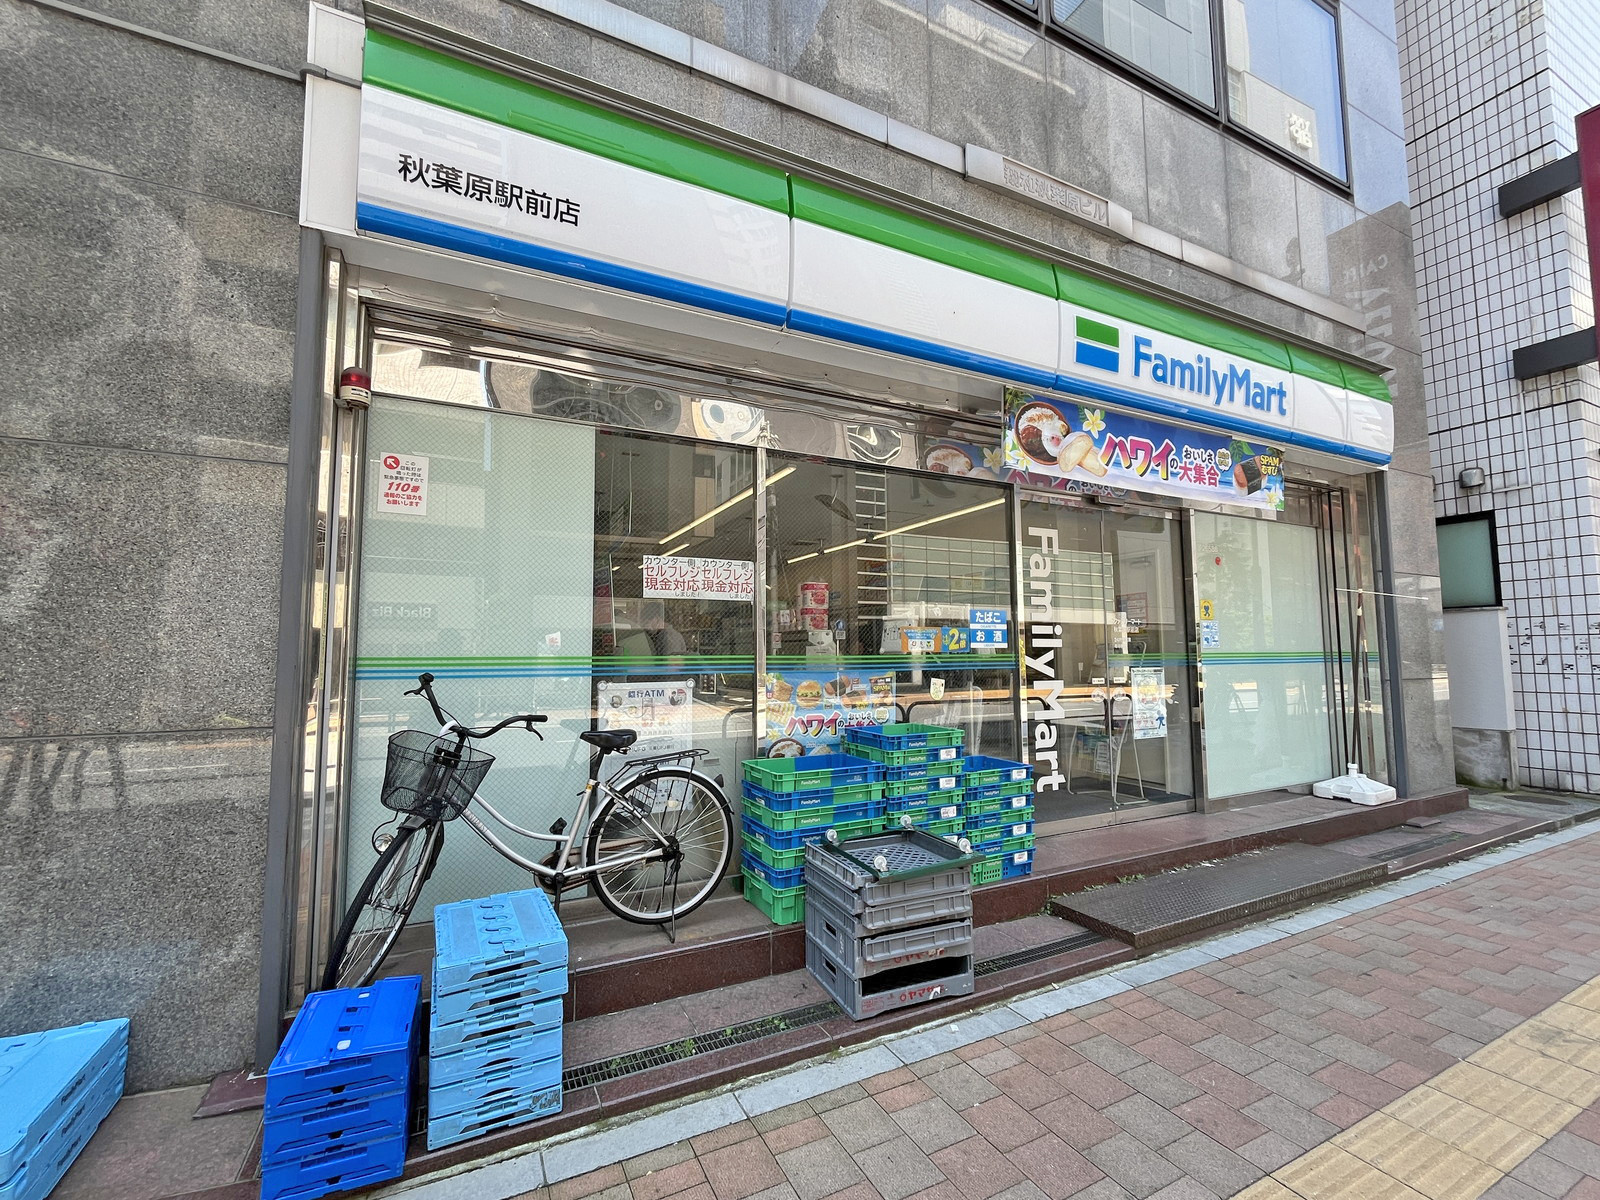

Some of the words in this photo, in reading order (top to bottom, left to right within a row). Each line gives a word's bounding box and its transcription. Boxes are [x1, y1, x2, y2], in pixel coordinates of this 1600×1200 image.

[398, 153, 581, 227] 秋葉原駅前店
[1133, 335, 1287, 416] FamilyMart
[1101, 435, 1178, 480] ハワイの
[1183, 447, 1214, 464] おいしさ
[1260, 455, 1280, 466] SPAM
[1179, 462, 1219, 487] 大集合
[1261, 466, 1278, 476] むすび
[388, 482, 420, 493] 110番
[384, 492, 422, 501] 通報のご協力を
[386, 499, 420, 507] お願いします
[644, 557, 695, 567] カウンター側
[702, 560, 750, 570] カウンター側
[645, 565, 700, 578] セルフレジ
[702, 568, 753, 580] セルフレジ
[645, 577, 700, 592] 現金対応
[701, 580, 754, 594] 現金対応
[975, 611, 1001, 623] たばこ
[976, 630, 1003, 642] お酒
[1025, 526, 1066, 793] FamilyMart
[627, 689, 665, 698] 銀行ATM
[785, 711, 844, 737] ハワイの
